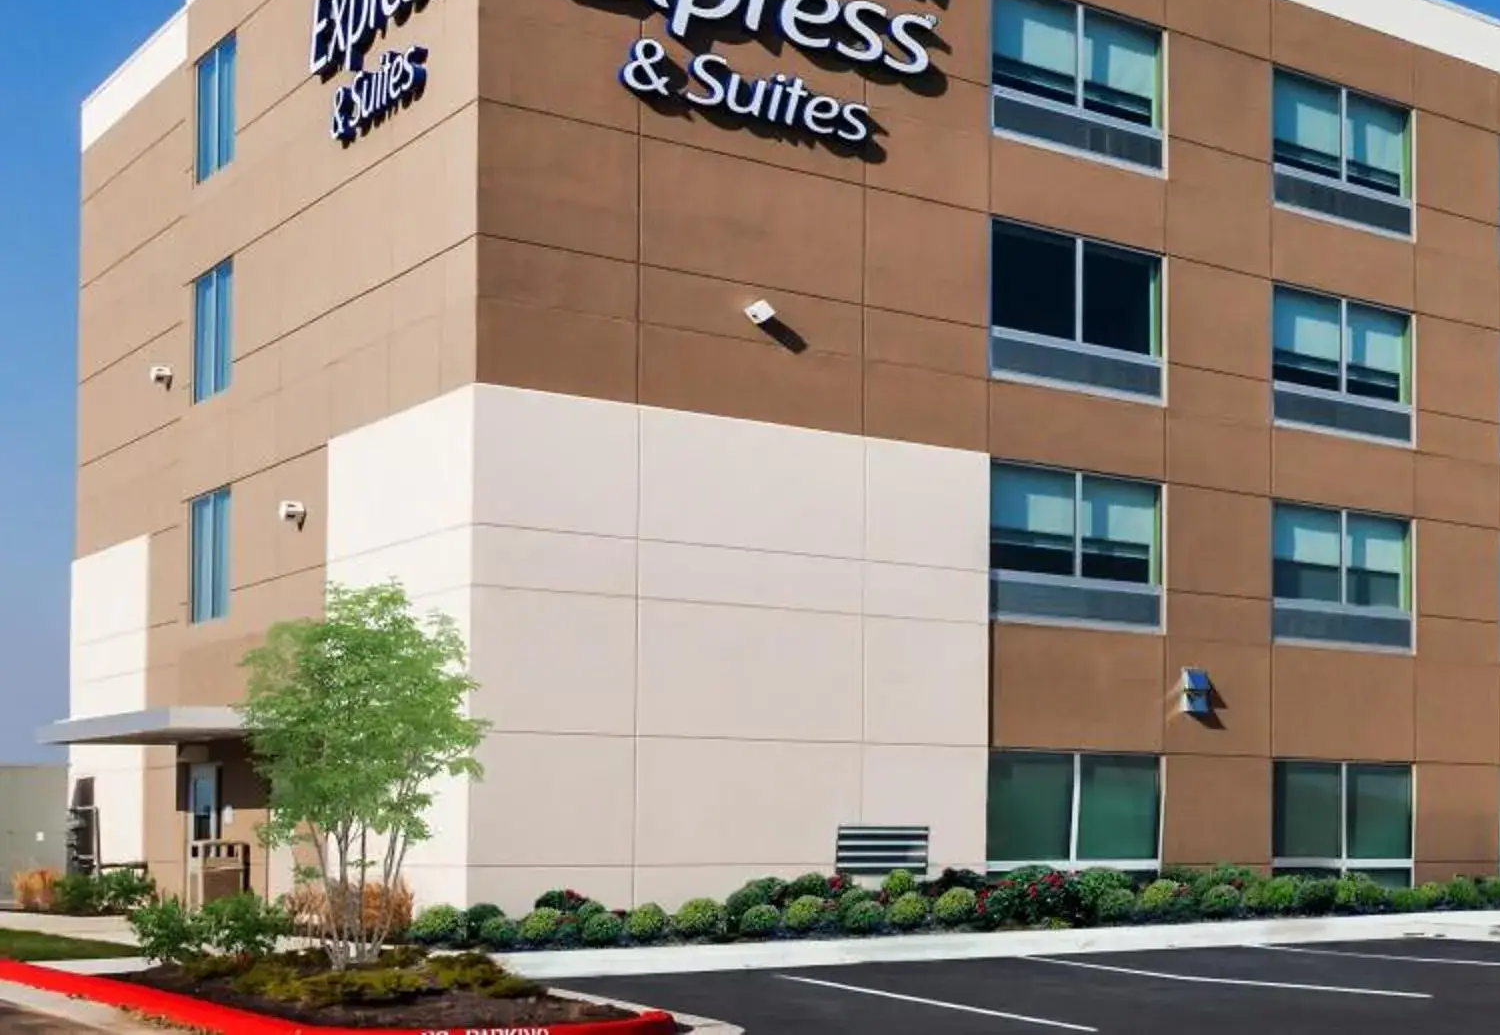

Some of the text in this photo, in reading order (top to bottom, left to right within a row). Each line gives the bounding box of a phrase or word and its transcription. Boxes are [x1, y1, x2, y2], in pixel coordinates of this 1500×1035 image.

[330, 46, 416, 140] & Suites
[620, 37, 871, 142] & Suites
